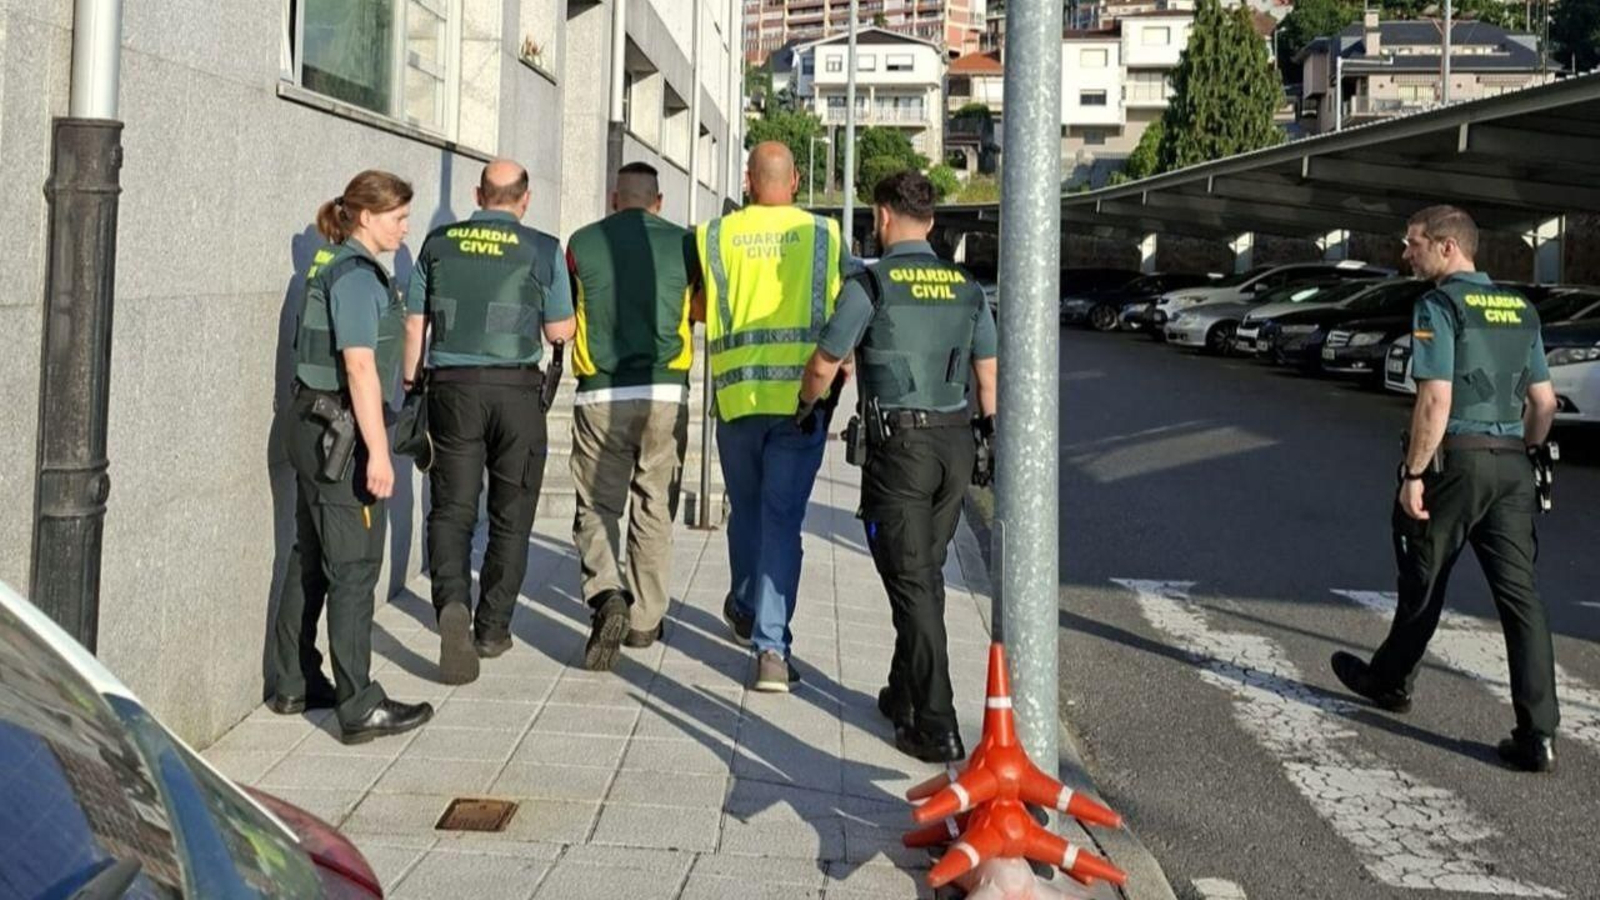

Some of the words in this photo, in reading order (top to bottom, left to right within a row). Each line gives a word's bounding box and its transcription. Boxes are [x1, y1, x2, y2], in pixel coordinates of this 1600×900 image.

[446, 228, 519, 244] GUARDIA
[732, 231, 800, 248] GUARDIA
[459, 240, 504, 256] CIVIL
[746, 246, 787, 259] CIVIL
[889, 268, 966, 284] GUARDIA
[911, 283, 957, 299] CIVIL
[1465, 294, 1527, 309] GUARDIA
[1484, 309, 1522, 323] CIVIL
